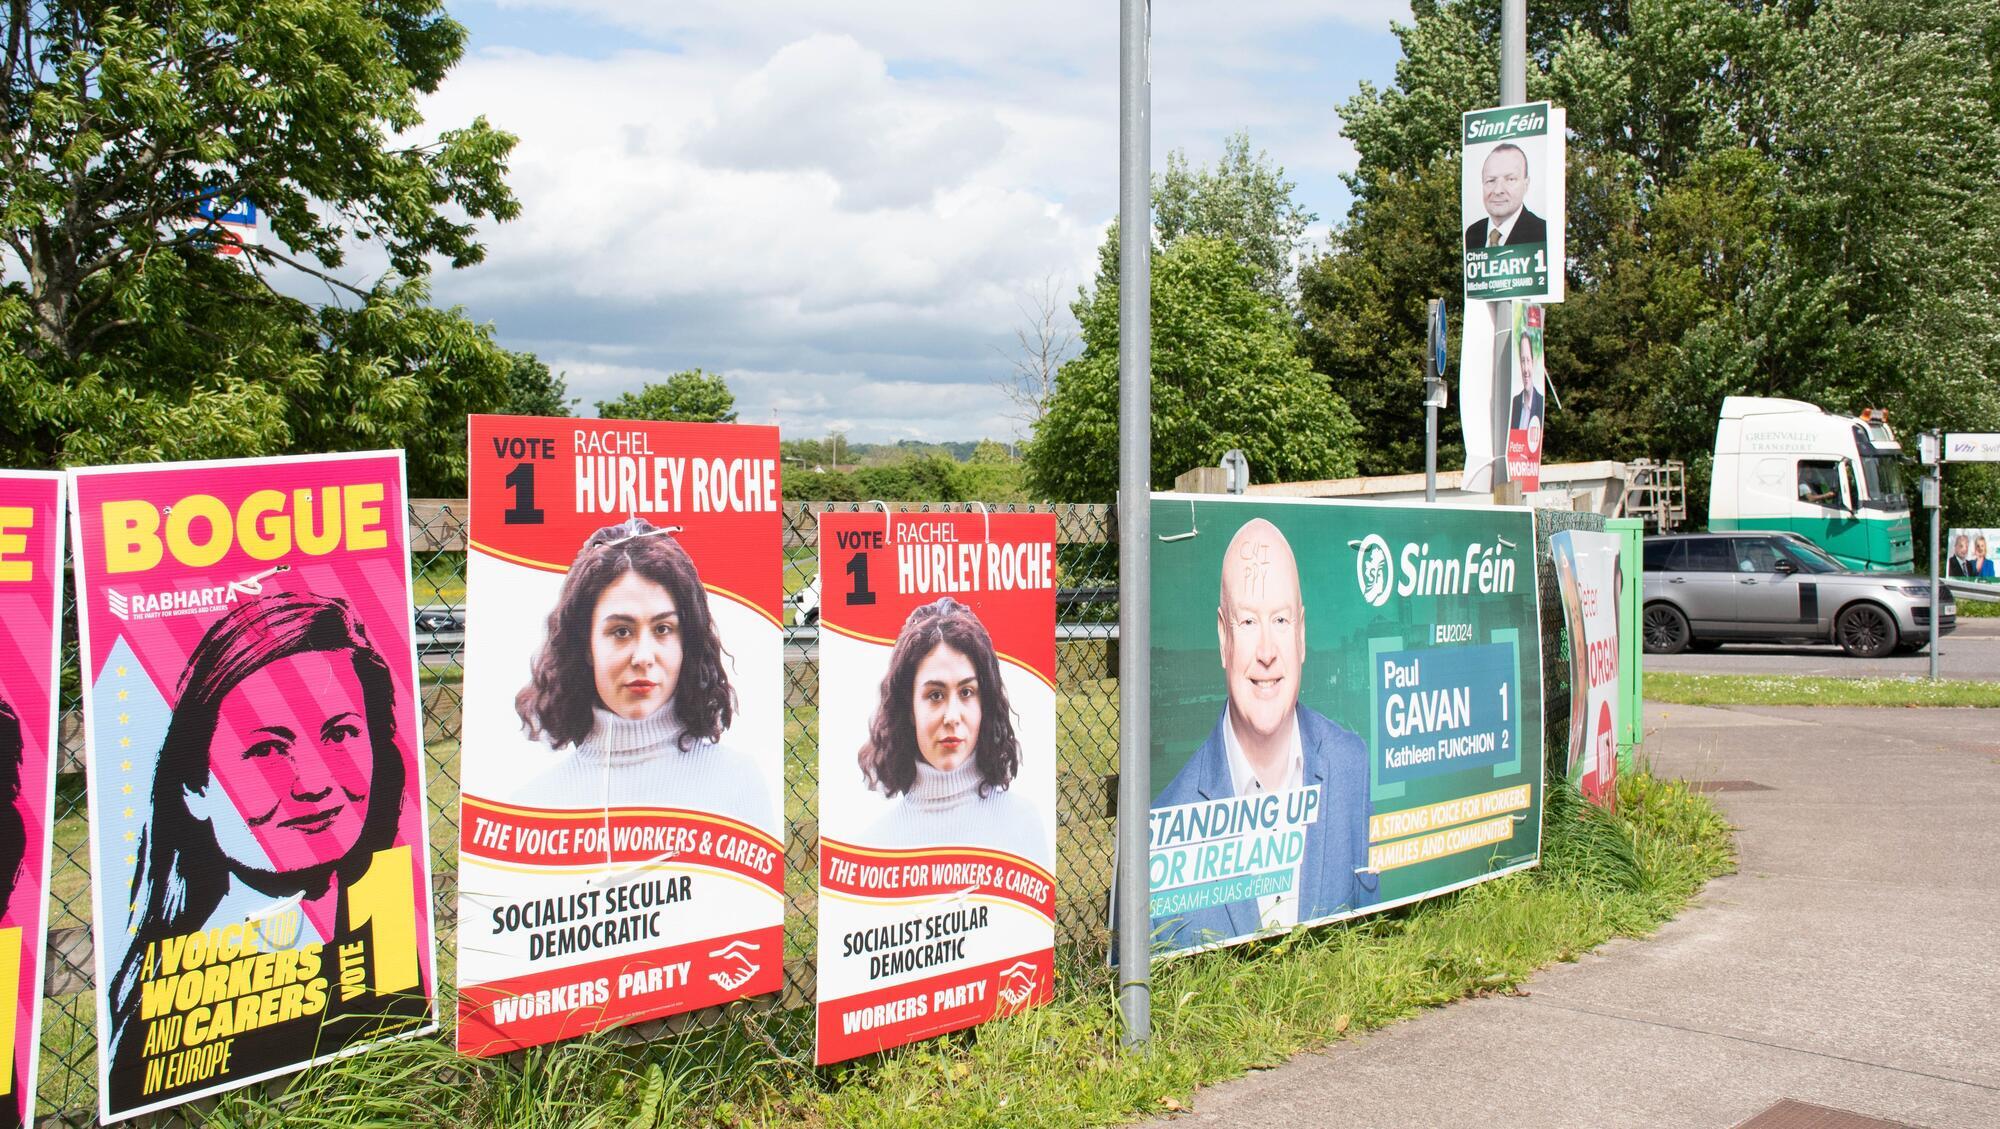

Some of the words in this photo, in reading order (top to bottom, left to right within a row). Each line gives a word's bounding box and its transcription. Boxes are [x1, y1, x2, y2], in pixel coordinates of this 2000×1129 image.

[1467, 119, 1505, 139] Sinn
[1505, 112, 1545, 134] Féin
[1466, 251, 1489, 261] Chris
[1467, 257, 1530, 279] O'LEARY
[1534, 249, 1547, 273] 1
[1538, 276, 1545, 286] 2
[493, 437, 556, 460] VOTE
[574, 430, 654, 455] RACHEL
[1745, 431, 1818, 442] GREENVALLEY
[1752, 443, 1813, 451] TRANSPORT
[505, 463, 544, 525] 1
[575, 455, 686, 513] HURLEY
[692, 457, 777, 513] ROCHE
[102, 483, 388, 574] BOGUE
[836, 530, 883, 550] VOTE
[897, 522, 959, 543] RACHEL
[846, 552, 876, 605] 1
[898, 543, 983, 594] HURLEY
[987, 542, 1052, 591] ROCHE
[1397, 542, 1460, 598] Sinn
[1462, 542, 1516, 595] Féin
[132, 583, 238, 613] RABHARTA
[162, 610, 172, 618] FOR
[1435, 624, 1473, 644] EU2024
[1384, 658, 1419, 689] Paul
[1587, 634, 1618, 689] ORGAN
[1385, 686, 1471, 739] GAVAN
[1499, 682, 1508, 721] 1
[1385, 747, 1435, 769] Kathleen
[1438, 732, 1495, 760] FUNCHION
[1501, 729, 1509, 750] 2
[1286, 789, 1318, 825] UP
[1371, 821, 1382, 838] A
[1382, 812, 1428, 836] STRONG
[1430, 804, 1460, 824] VOICE
[1461, 799, 1479, 818] FOR
[473, 817, 512, 852] THE
[515, 827, 570, 856] VOICE
[574, 828, 608, 853] FOR
[613, 826, 697, 853] WORKERS
[699, 831, 712, 855] &
[716, 834, 777, 876] CARERS
[1149, 850, 1187, 890] OR
[1193, 830, 1304, 881] IRELAND
[1371, 844, 1419, 868] FAMILIES
[1421, 838, 1445, 857] AND
[1446, 818, 1509, 850] COMMUNITIES
[492, 890, 600, 935] SOCIALIST
[606, 875, 692, 914] SECULAR
[828, 857, 858, 885] THE
[860, 866, 899, 889] VOICE
[902, 865, 929, 888] FOR
[932, 863, 993, 886] WORKERS
[994, 867, 1004, 888] &
[1005, 869, 1050, 905] CARERS
[1150, 889, 1209, 917] SEASAMH
[1210, 882, 1243, 906] SUAS
[140, 942, 156, 981] A
[161, 920, 260, 976] VOICE
[264, 910, 298, 951] FOR
[347, 845, 419, 997] 1
[530, 911, 661, 961] DEMOCRATIC
[843, 918, 922, 958] SOCIALIST
[925, 905, 988, 942] SECULAR
[141, 942, 324, 1021] WORKERS
[338, 940, 366, 1002] VOTE
[870, 936, 965, 980] DEMOCRATIC
[142, 1015, 183, 1058] AND
[182, 977, 329, 1046] CARERS
[493, 978, 609, 1025] WORKERS
[618, 961, 692, 999] PARTY
[842, 994, 928, 1036] WORKERS
[934, 980, 987, 1013] PARTY
[143, 1057, 167, 1096] IN
[165, 1038, 235, 1090] EUROPE
